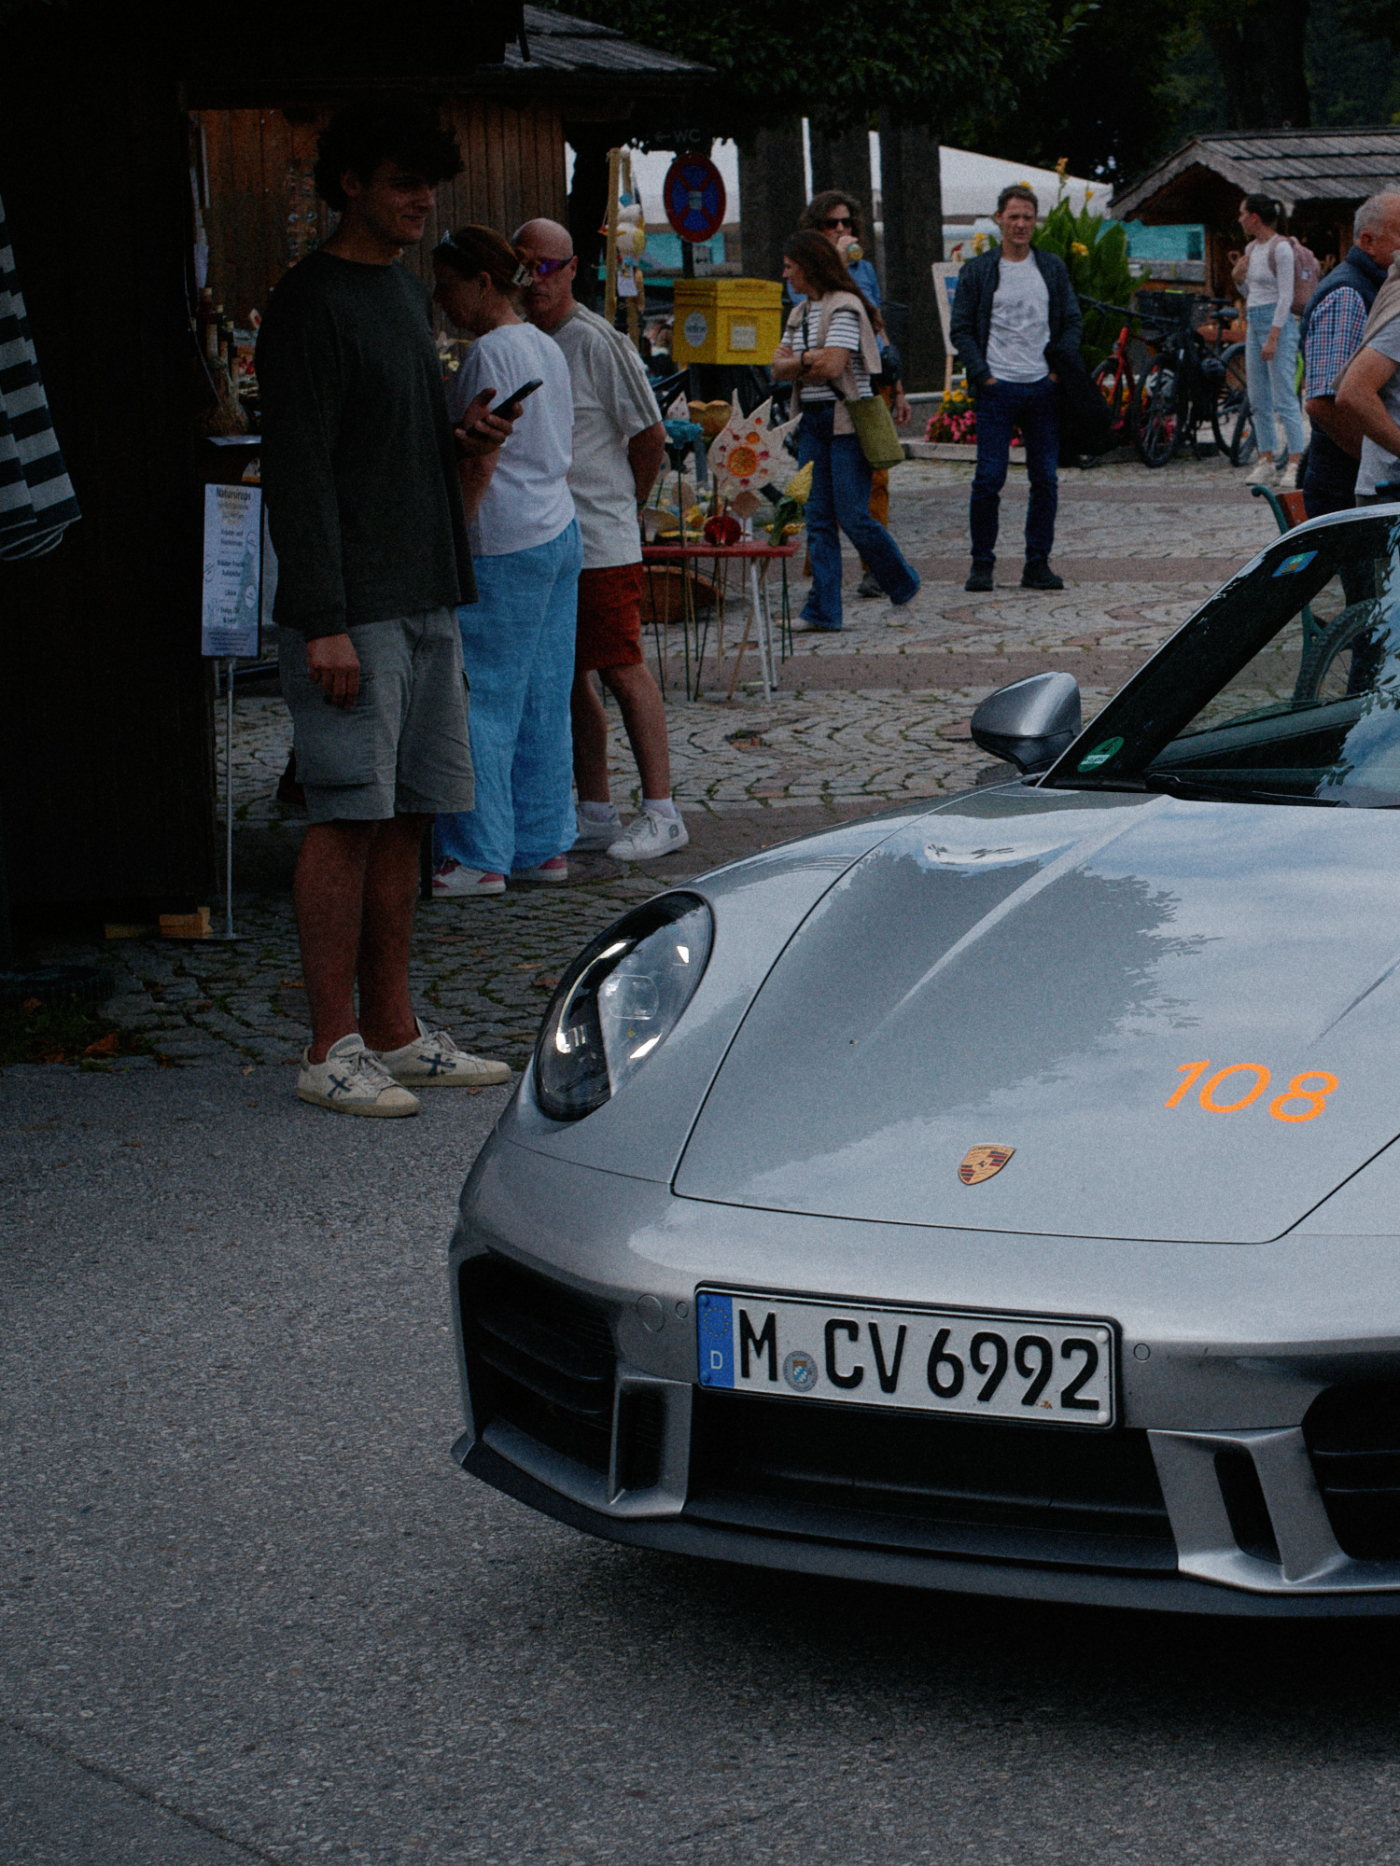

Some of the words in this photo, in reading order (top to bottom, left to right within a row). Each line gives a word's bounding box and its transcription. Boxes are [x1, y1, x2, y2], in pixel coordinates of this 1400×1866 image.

[672, 128, 702, 143] WC
[1164, 1059, 1339, 1123] 108
[710, 1349, 724, 1370] D
[739, 1309, 778, 1382] M
[824, 1317, 908, 1394] CV
[926, 1328, 1100, 1411] 6992
